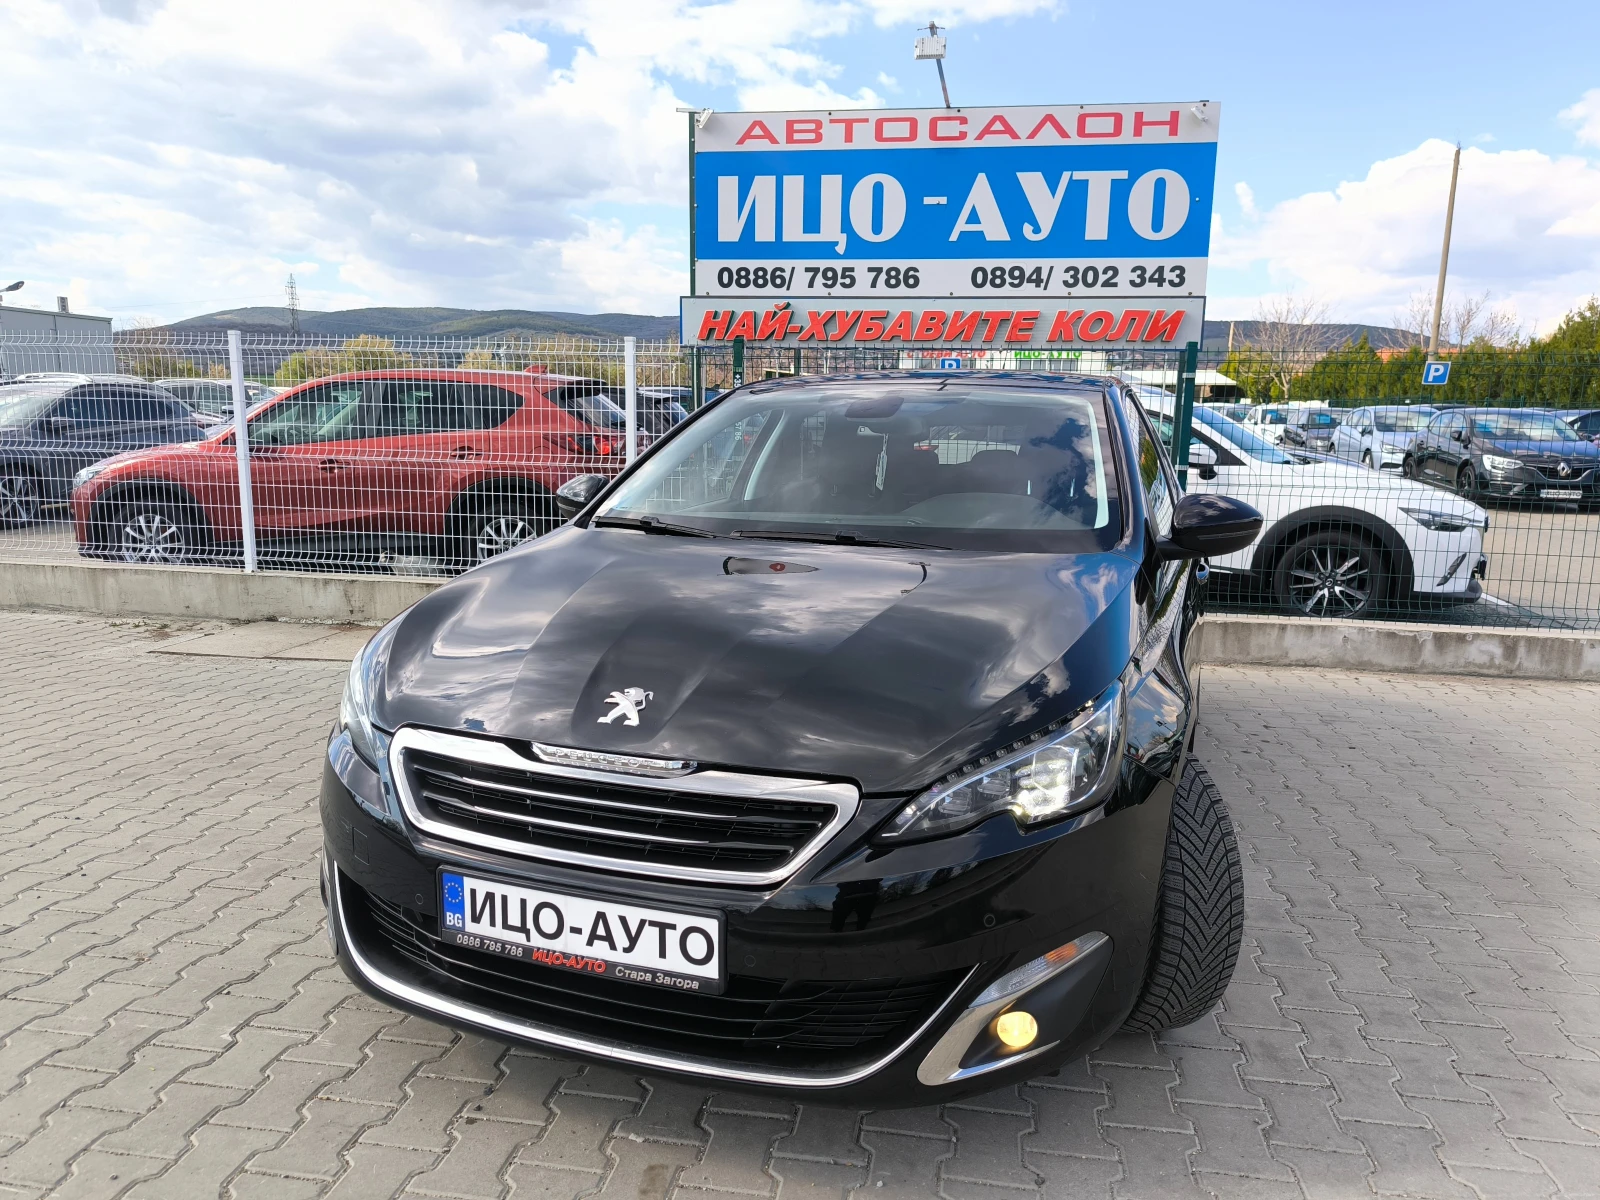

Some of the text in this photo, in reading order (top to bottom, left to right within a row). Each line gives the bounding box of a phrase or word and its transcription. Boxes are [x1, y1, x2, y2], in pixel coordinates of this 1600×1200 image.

[735, 110, 1180, 145] АВТОСАЛОН
[717, 266, 920, 291] 0886/ 795 786
[971, 264, 1187, 291] 0894/ 302 343
[697, 301, 1187, 342] НАЙ-ХУБАВИТЕ КОЛИ
[1427, 364, 1444, 382] P
[446, 911, 463, 928] BG
[469, 887, 715, 966] ИЦО-АУТО
[456, 933, 523, 957] 0886 795 786
[532, 948, 606, 973] ИЦО-АУТО
[615, 966, 699, 990] Стара Загора
